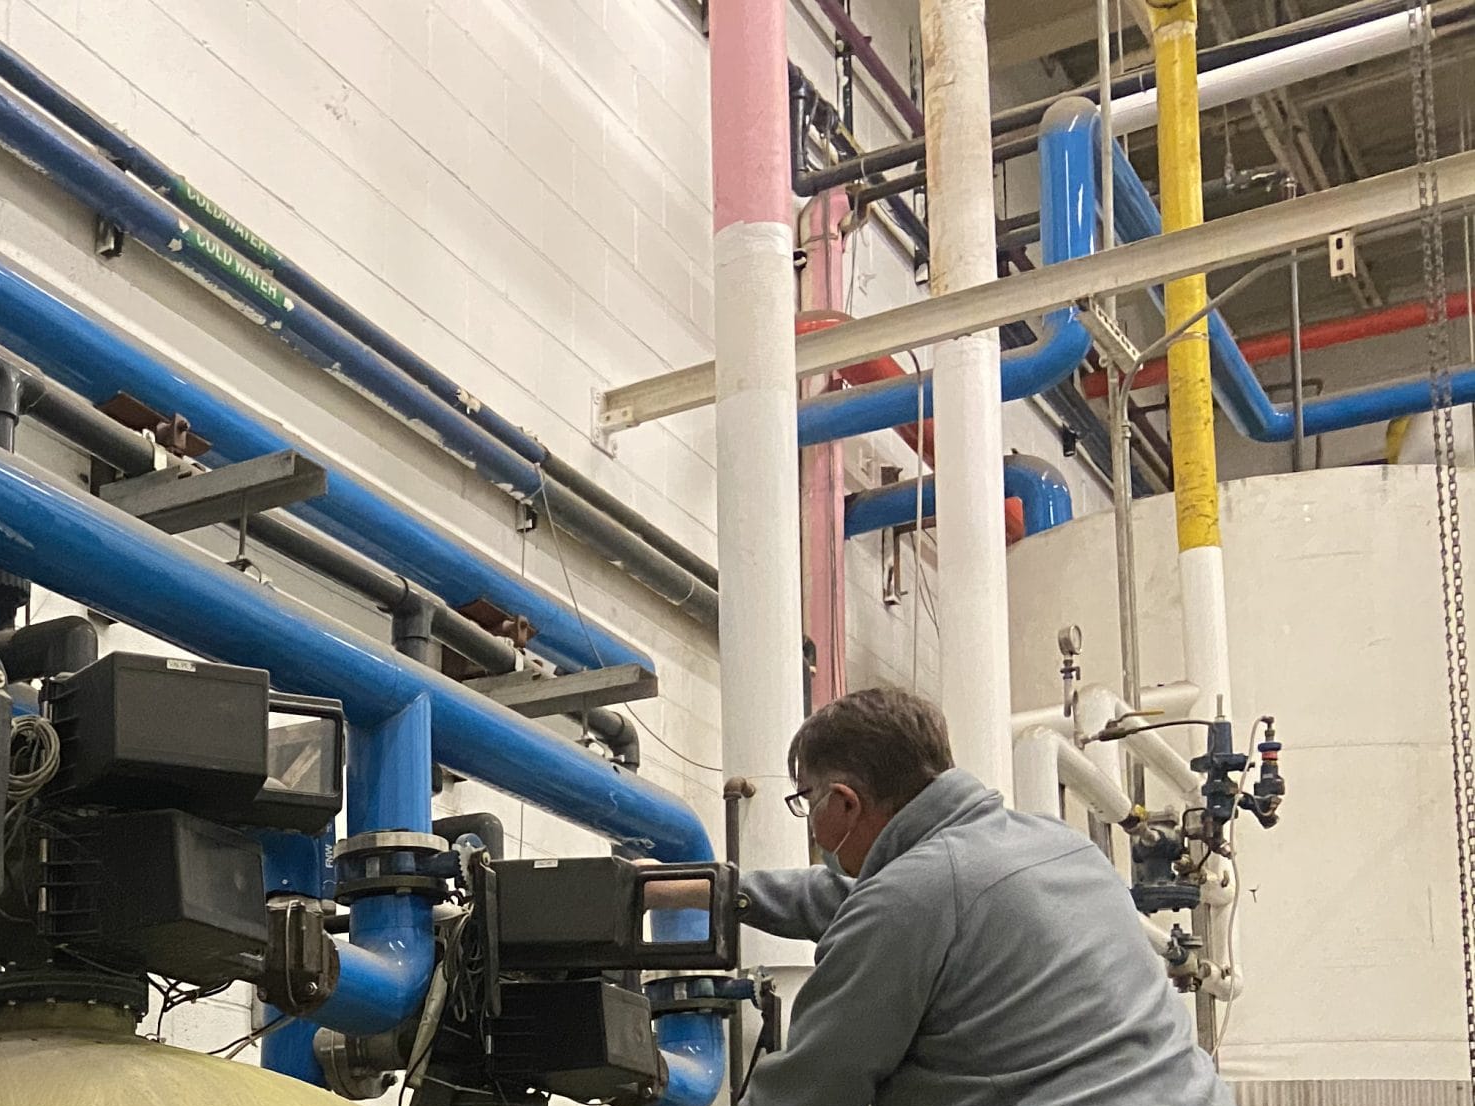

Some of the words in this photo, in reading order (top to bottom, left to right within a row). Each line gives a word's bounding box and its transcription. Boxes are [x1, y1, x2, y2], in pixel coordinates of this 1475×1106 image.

[196, 232, 233, 266] COLD
[234, 257, 278, 300] WATER
[325, 844, 334, 868] FNW
